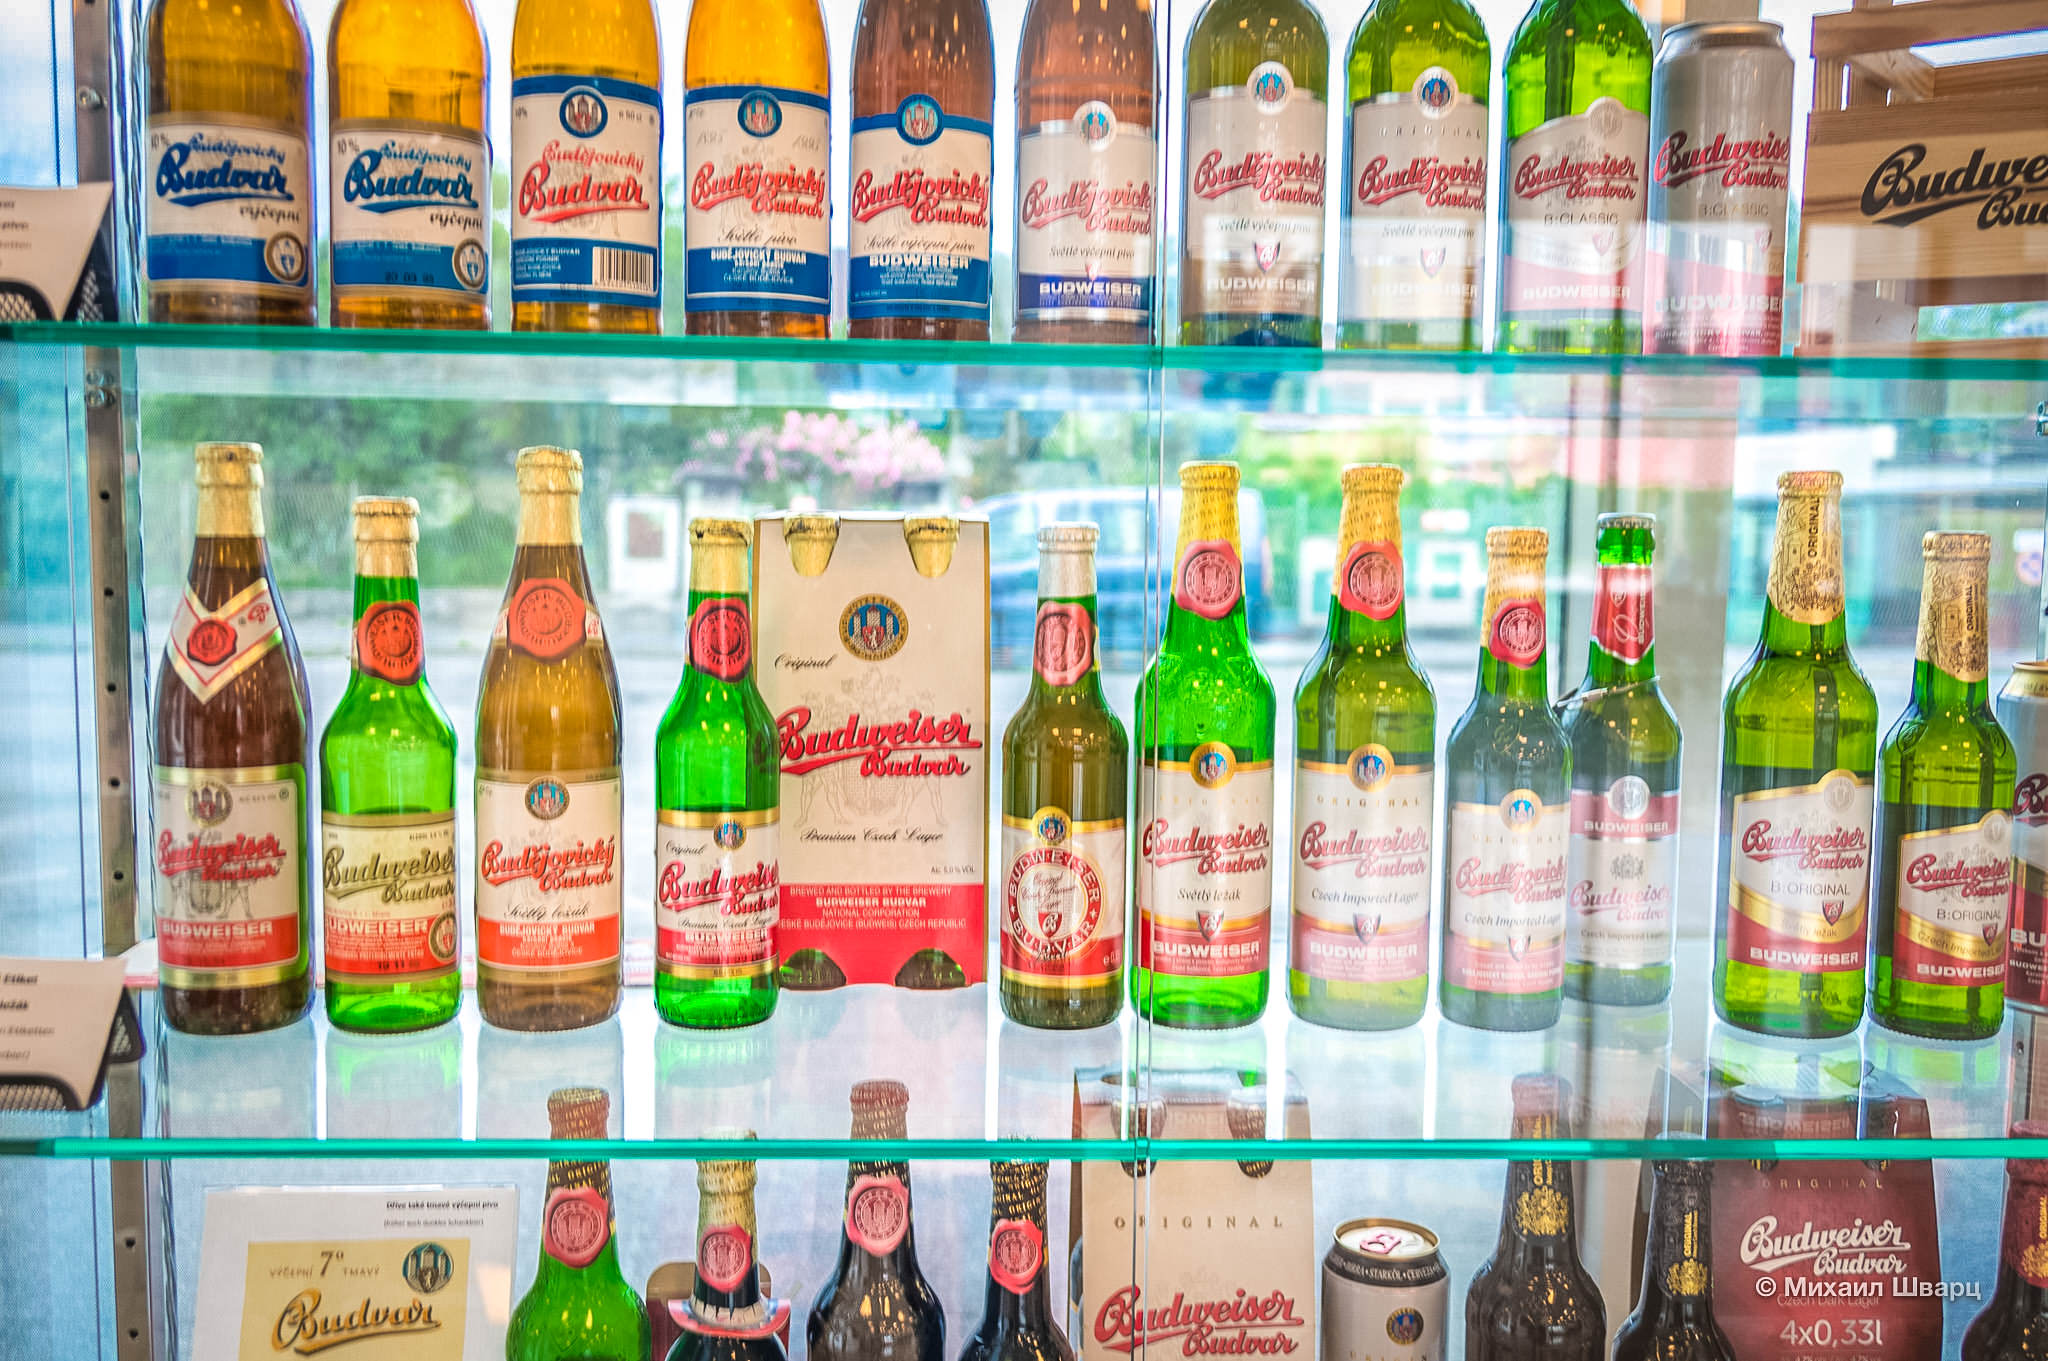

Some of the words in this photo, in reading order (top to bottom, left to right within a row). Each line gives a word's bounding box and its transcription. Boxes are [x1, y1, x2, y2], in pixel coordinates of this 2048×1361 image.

[542, 139, 645, 175] Budějovický
[156, 142, 292, 200] Budvar
[343, 149, 475, 203] Budvar
[1514, 150, 1637, 197] Budweiser
[519, 161, 646, 218] Budvar
[690, 160, 826, 208] Budějovický
[852, 167, 990, 217] Budějovický
[1564, 177, 1637, 201] Budvar
[240, 205, 301, 224] výčepní
[751, 193, 826, 220] Budvar
[910, 200, 988, 229] Budvar
[429, 211, 483, 232] výčepní
[869, 254, 970, 270] BUDWEISER
[1040, 282, 1142, 298] BUDWEISER
[1207, 276, 1315, 298] BUDWEISER
[1523, 285, 1631, 300] BUDWEISER
[1806, 496, 1821, 559] ORIGINAL
[773, 653, 838, 672] Original
[779, 705, 974, 762] Budweiser
[860, 745, 971, 778] Budvar
[1316, 795, 1421, 808] ORIGINAL
[800, 826, 857, 843] Premium
[863, 824, 898, 842] Czech
[904, 824, 945, 846] Lager
[1143, 817, 1270, 857] Budweiser
[1584, 821, 1669, 833] BUDWEISER
[1741, 819, 1867, 853] Budweiser
[665, 839, 709, 857] Original
[1299, 820, 1429, 861] Budweiser
[481, 834, 615, 880] Budějovický
[1198, 850, 1268, 876] Budvar
[1354, 854, 1426, 879] Budvar
[1798, 850, 1865, 871] Budvar
[538, 867, 614, 893] Budvar
[1009, 847, 1101, 903] BUDWEISER
[790, 886, 826, 896] BREWED
[826, 886, 843, 896] AND
[844, 886, 881, 896] BOTTLED
[882, 886, 893, 896] BY
[895, 886, 911, 896] THE
[912, 886, 952, 896] BREWERY
[1177, 886, 1212, 902] Světlý
[1213, 886, 1242, 901] ležák
[1311, 887, 1341, 903] Czech
[1342, 890, 1392, 906] Imported
[1770, 879, 1851, 896] B:ORIGINAL
[816, 896, 879, 908] BUDWEISER
[882, 896, 927, 908] BUDVAR
[822, 908, 860, 919] NATIONAL
[862, 908, 920, 919] CORPORATION
[162, 920, 273, 938] BUDWEISER
[326, 918, 428, 936] UDWEISER
[898, 917, 927, 929] CZECH
[927, 917, 967, 929] REPUBLIC
[1464, 912, 1494, 925] Czech
[1495, 914, 1542, 929] Imported
[1013, 920, 1095, 955] BUDVAR
[1153, 940, 1260, 959] BUDWEISER
[1310, 940, 1418, 961] BUDWEISER
[1749, 947, 1859, 966] BUDWEISER
[1762, 1178, 1882, 1190] ORIGINAL
[1113, 1215, 1284, 1231] ORIGINAL
[1740, 1215, 1904, 1266] Budweiser
[269, 1265, 314, 1279] VÝČEPNÍ
[342, 1265, 380, 1279] TMAVÝ
[1813, 1250, 1908, 1277] Budvar
[271, 1288, 434, 1352] Budvar
[1094, 1285, 1294, 1343] Budweiser
[1182, 1324, 1299, 1357] Budvar
[1779, 1318, 1884, 1349] 4x0,33l
